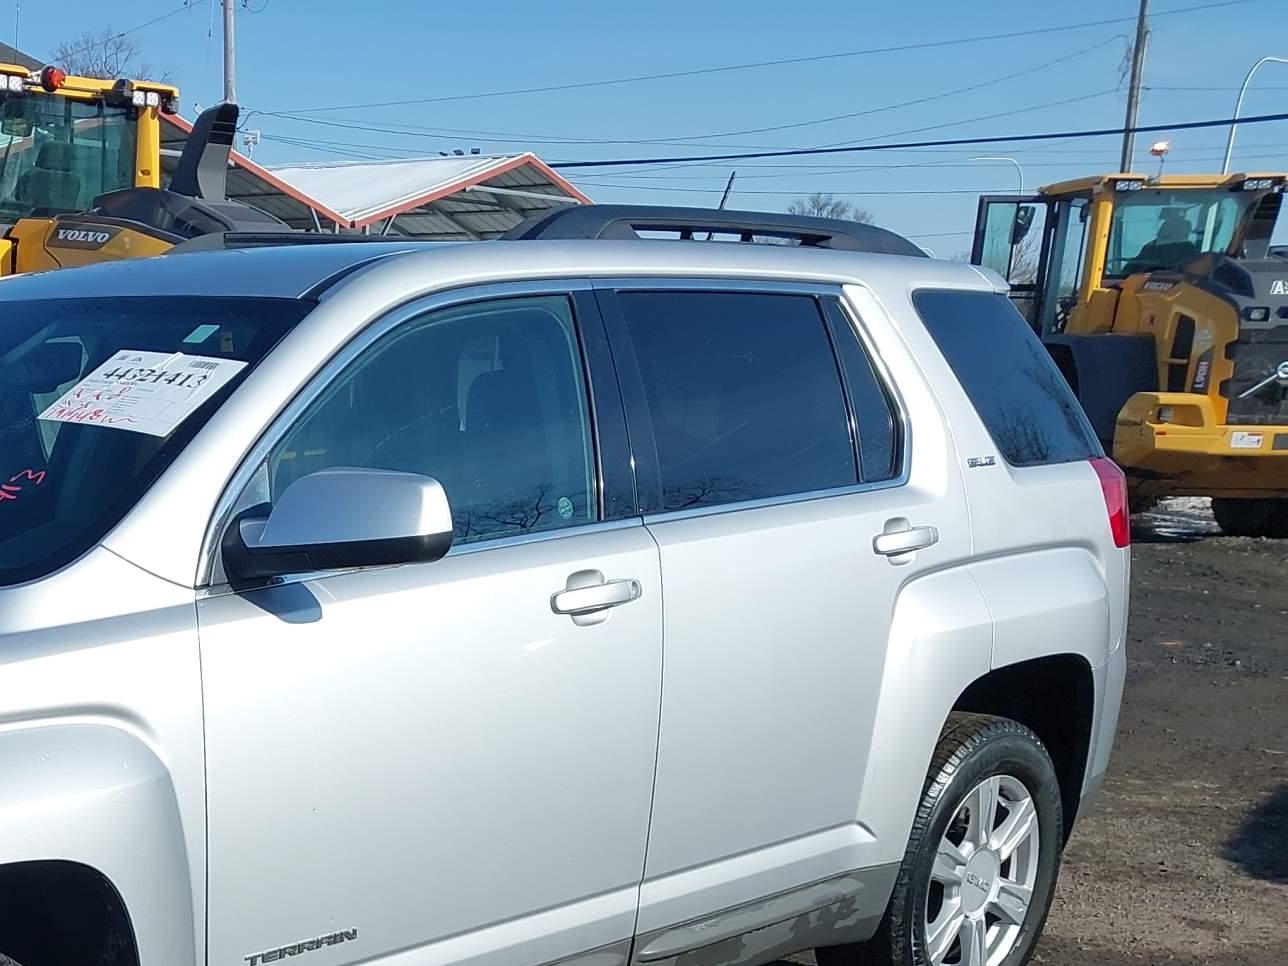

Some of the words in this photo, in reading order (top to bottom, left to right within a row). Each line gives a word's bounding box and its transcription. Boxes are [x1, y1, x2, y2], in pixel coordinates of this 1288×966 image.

[57, 229, 110, 243] VOLVO
[103, 366, 208, 389] 44321413
[243, 926, 359, 966] TERRAIN
